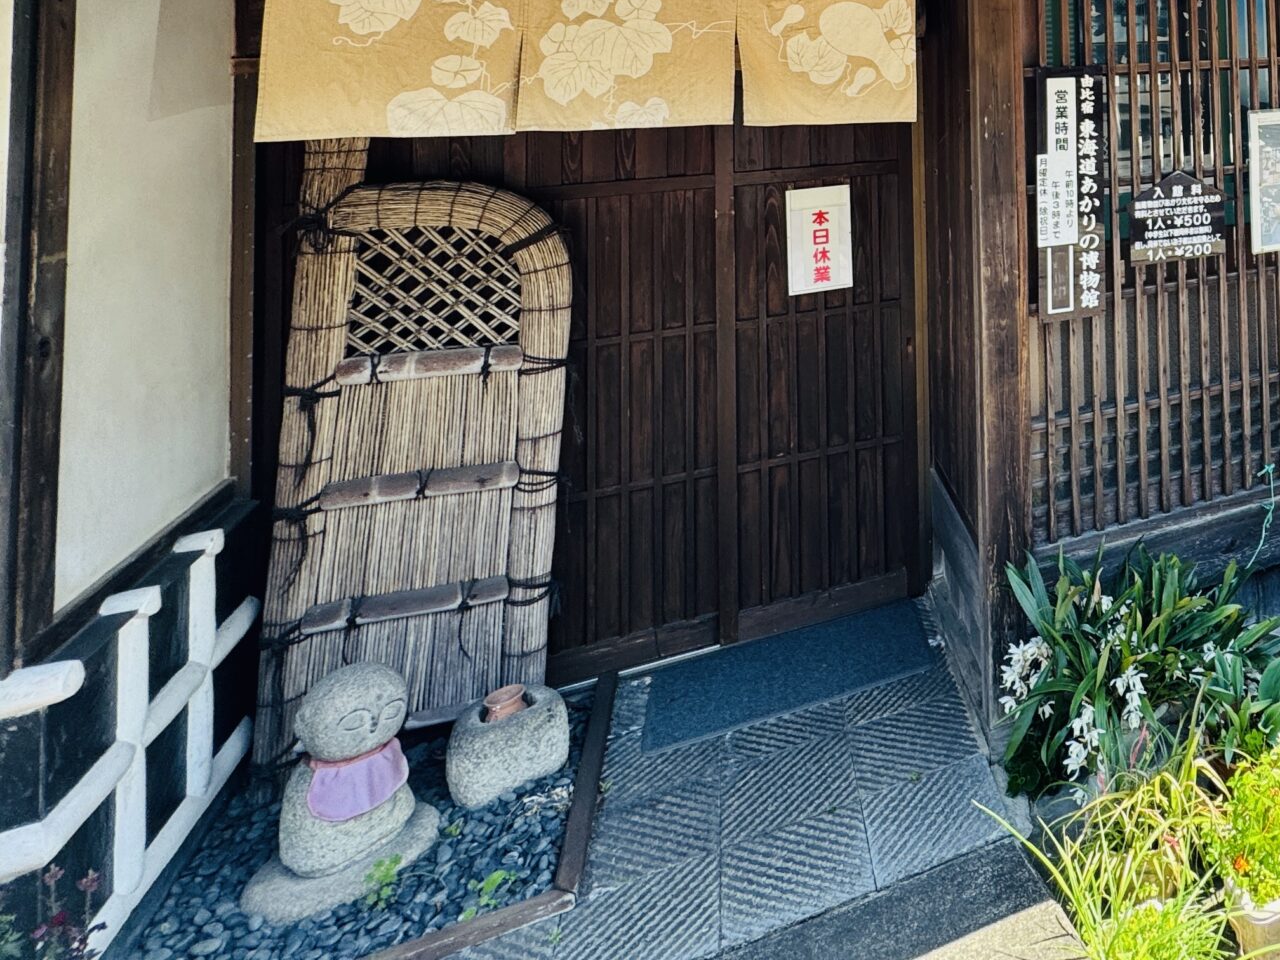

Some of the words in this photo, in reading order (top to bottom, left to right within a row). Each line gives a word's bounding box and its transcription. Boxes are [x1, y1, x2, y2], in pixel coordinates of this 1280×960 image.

[1054, 89, 1069, 152] 営業時間
[1079, 74, 1095, 114] 由比宿
[812, 209, 831, 284] 本日休業
[1078, 118, 1101, 309] 東海道あかりの博物館
